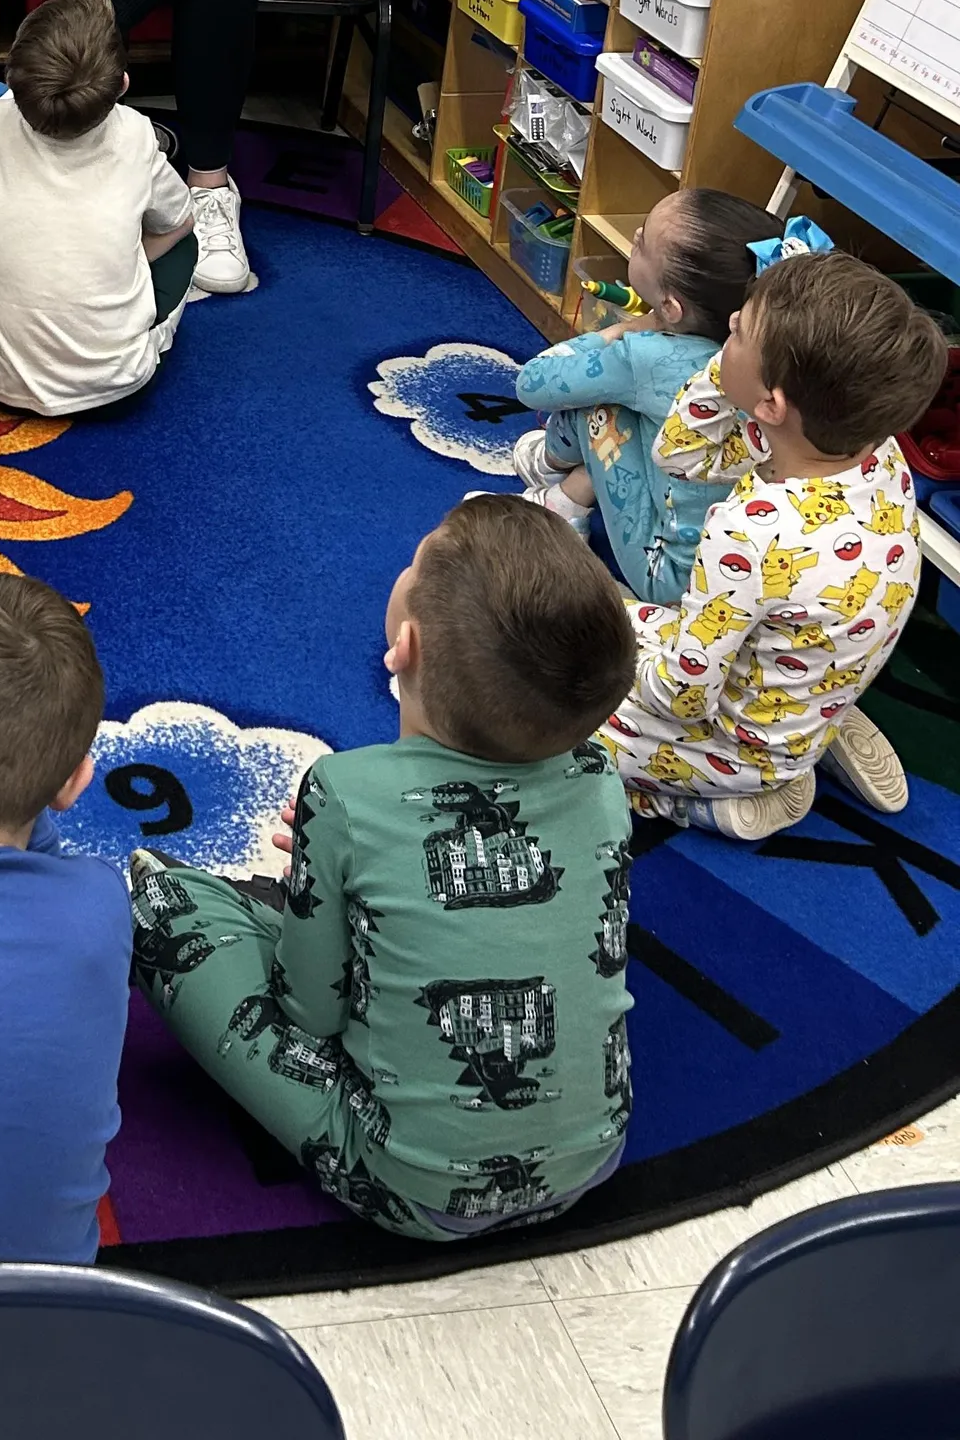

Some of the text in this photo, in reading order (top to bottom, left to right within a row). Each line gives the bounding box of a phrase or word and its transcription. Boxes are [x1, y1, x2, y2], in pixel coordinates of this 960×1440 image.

[655, 1, 678, 26] Words
[610, 97, 657, 145] Sight Words
